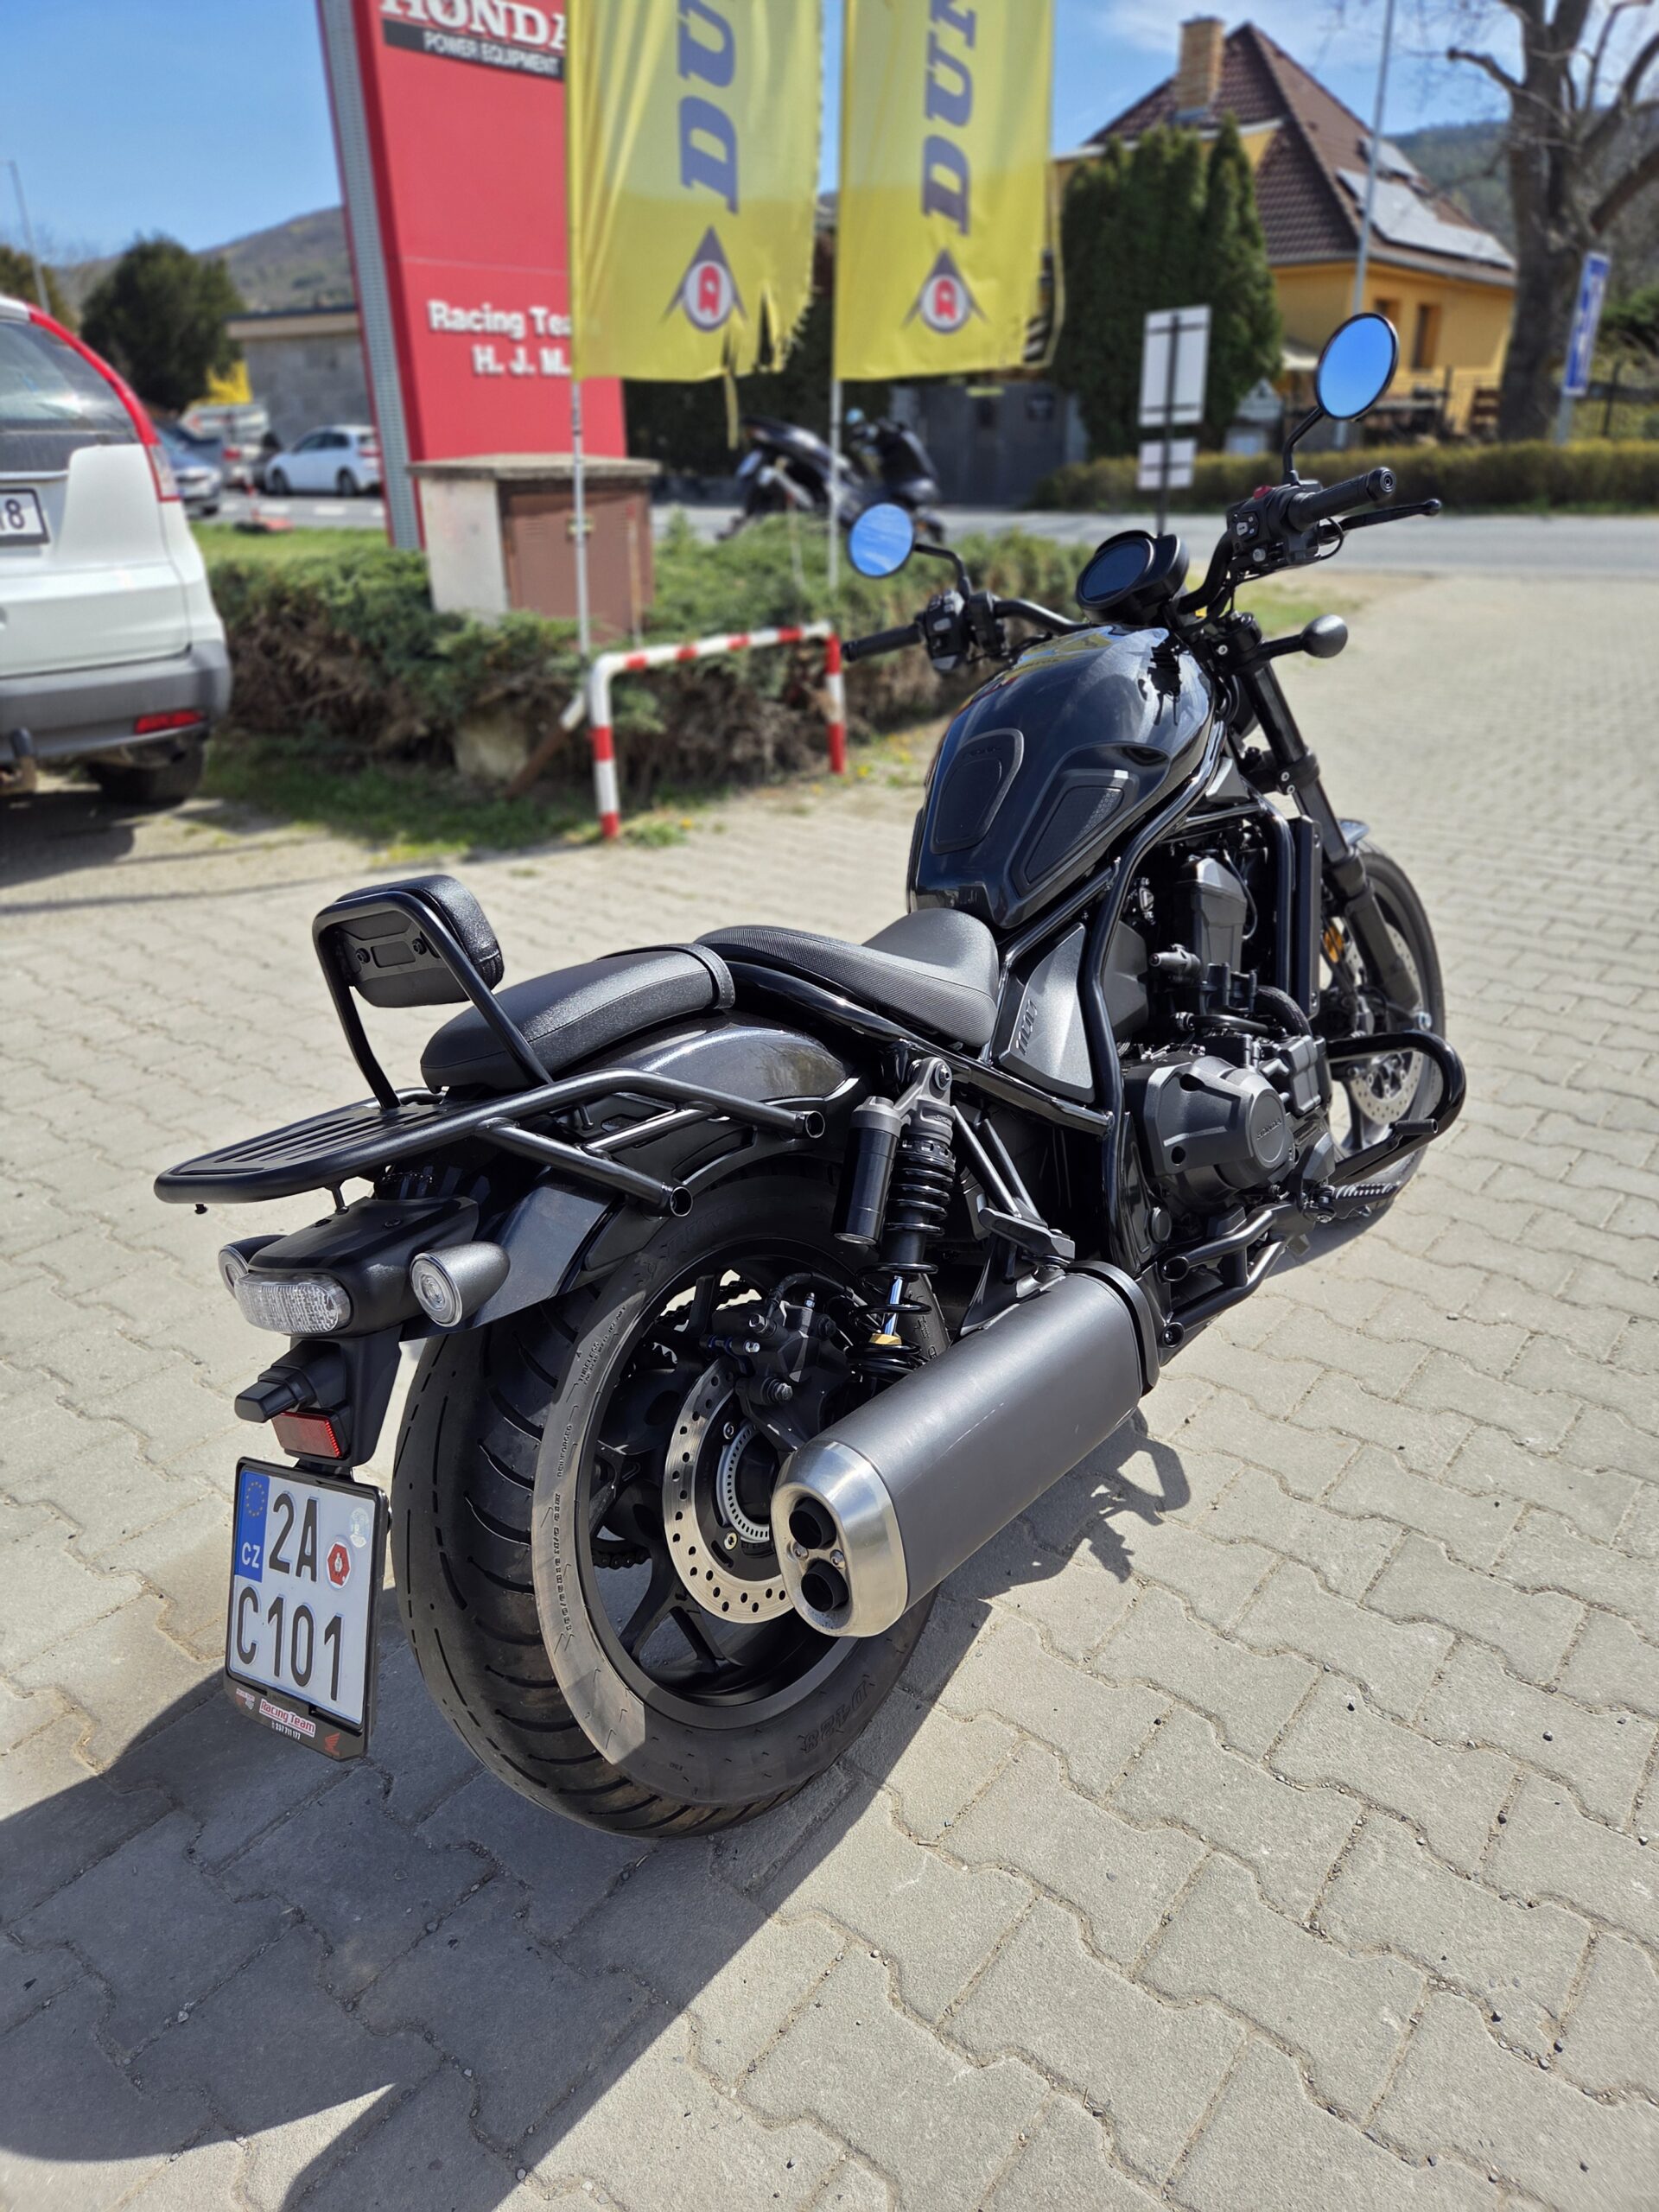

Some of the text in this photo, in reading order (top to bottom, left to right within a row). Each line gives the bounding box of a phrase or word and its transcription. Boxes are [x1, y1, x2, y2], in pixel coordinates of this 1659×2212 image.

[423, 30, 561, 76] POWER EQUIPMENT
[428, 299, 524, 340] Racing
[472, 344, 505, 375] H.
[508, 346, 536, 375] J.
[242, 1541, 261, 1569] CZ
[269, 1493, 318, 1582] 2A
[236, 1586, 342, 1701] C101
[261, 1700, 289, 1723] Racing
[289, 1713, 315, 1732] Team
